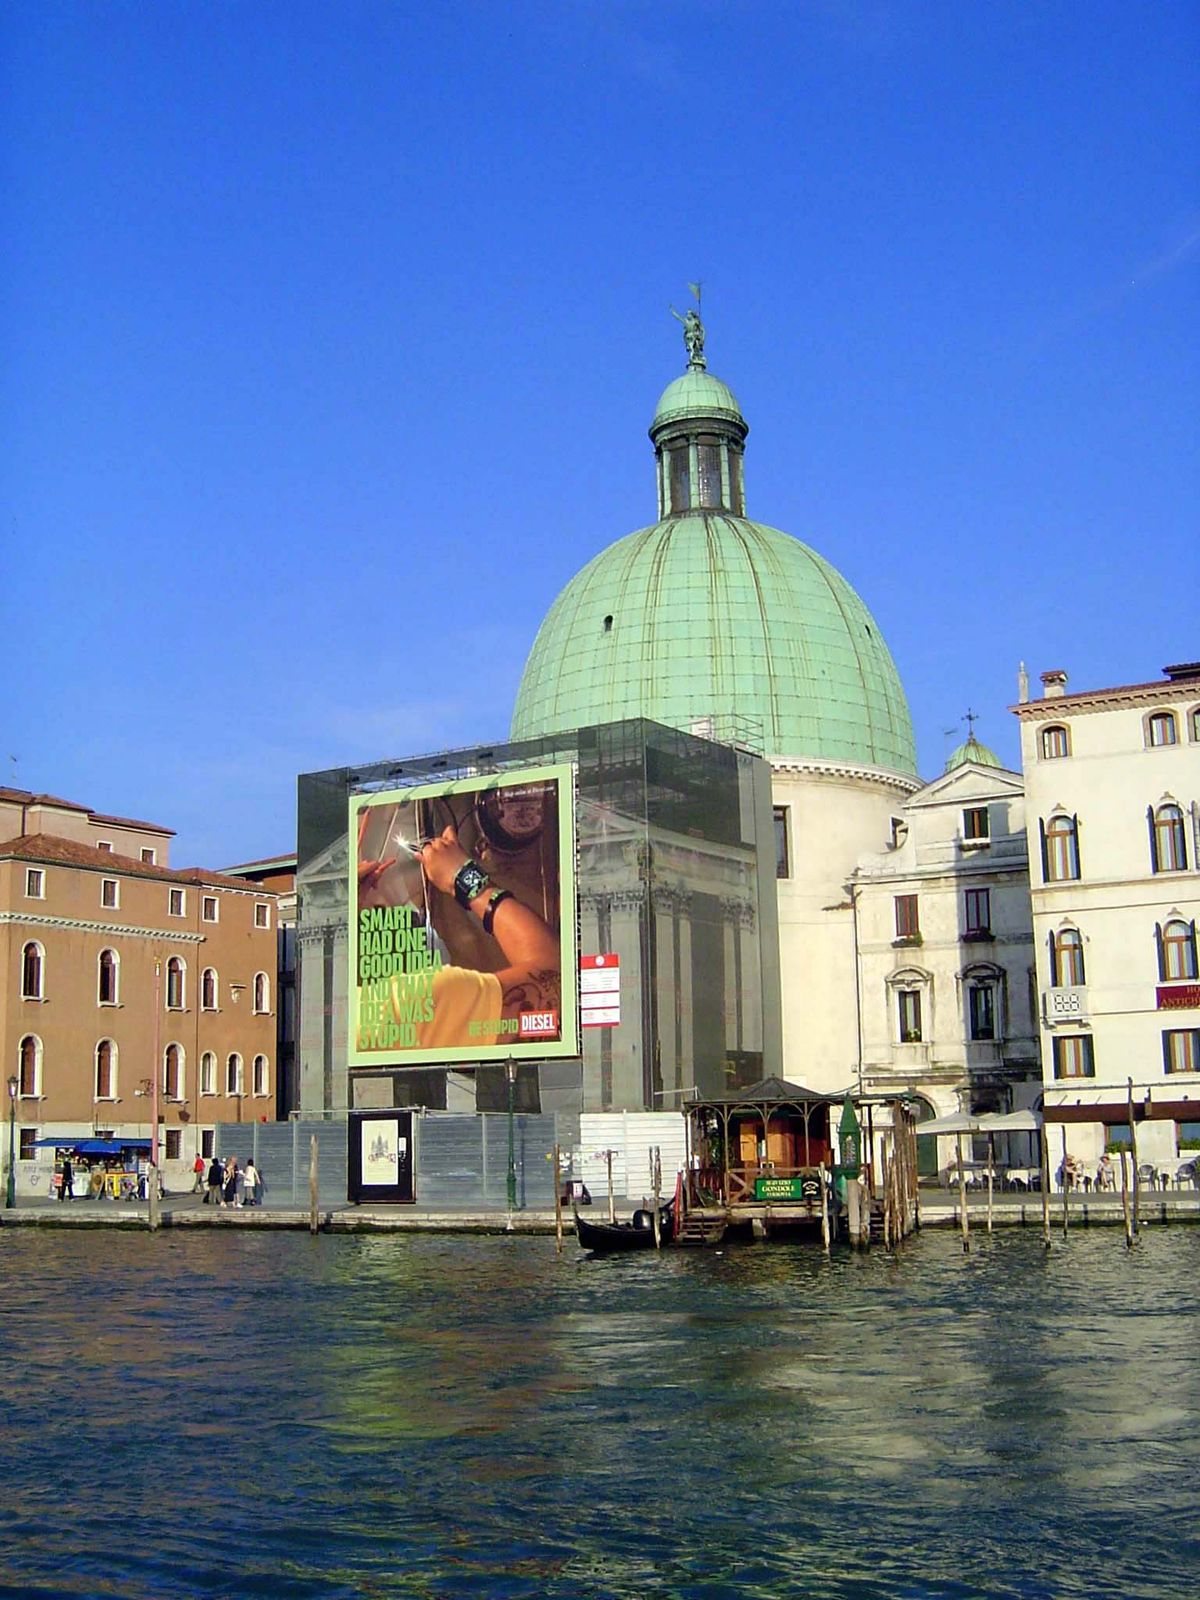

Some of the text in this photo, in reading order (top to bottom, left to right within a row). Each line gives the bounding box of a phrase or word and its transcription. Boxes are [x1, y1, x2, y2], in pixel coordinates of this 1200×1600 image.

[360, 906, 412, 932] SMART
[360, 927, 427, 955] HAD ONE
[360, 949, 442, 978] GOOD IDEA
[360, 973, 433, 1001] AND THAT
[360, 997, 435, 1025] IDEA WAS
[521, 1014, 555, 1030] DIESEL
